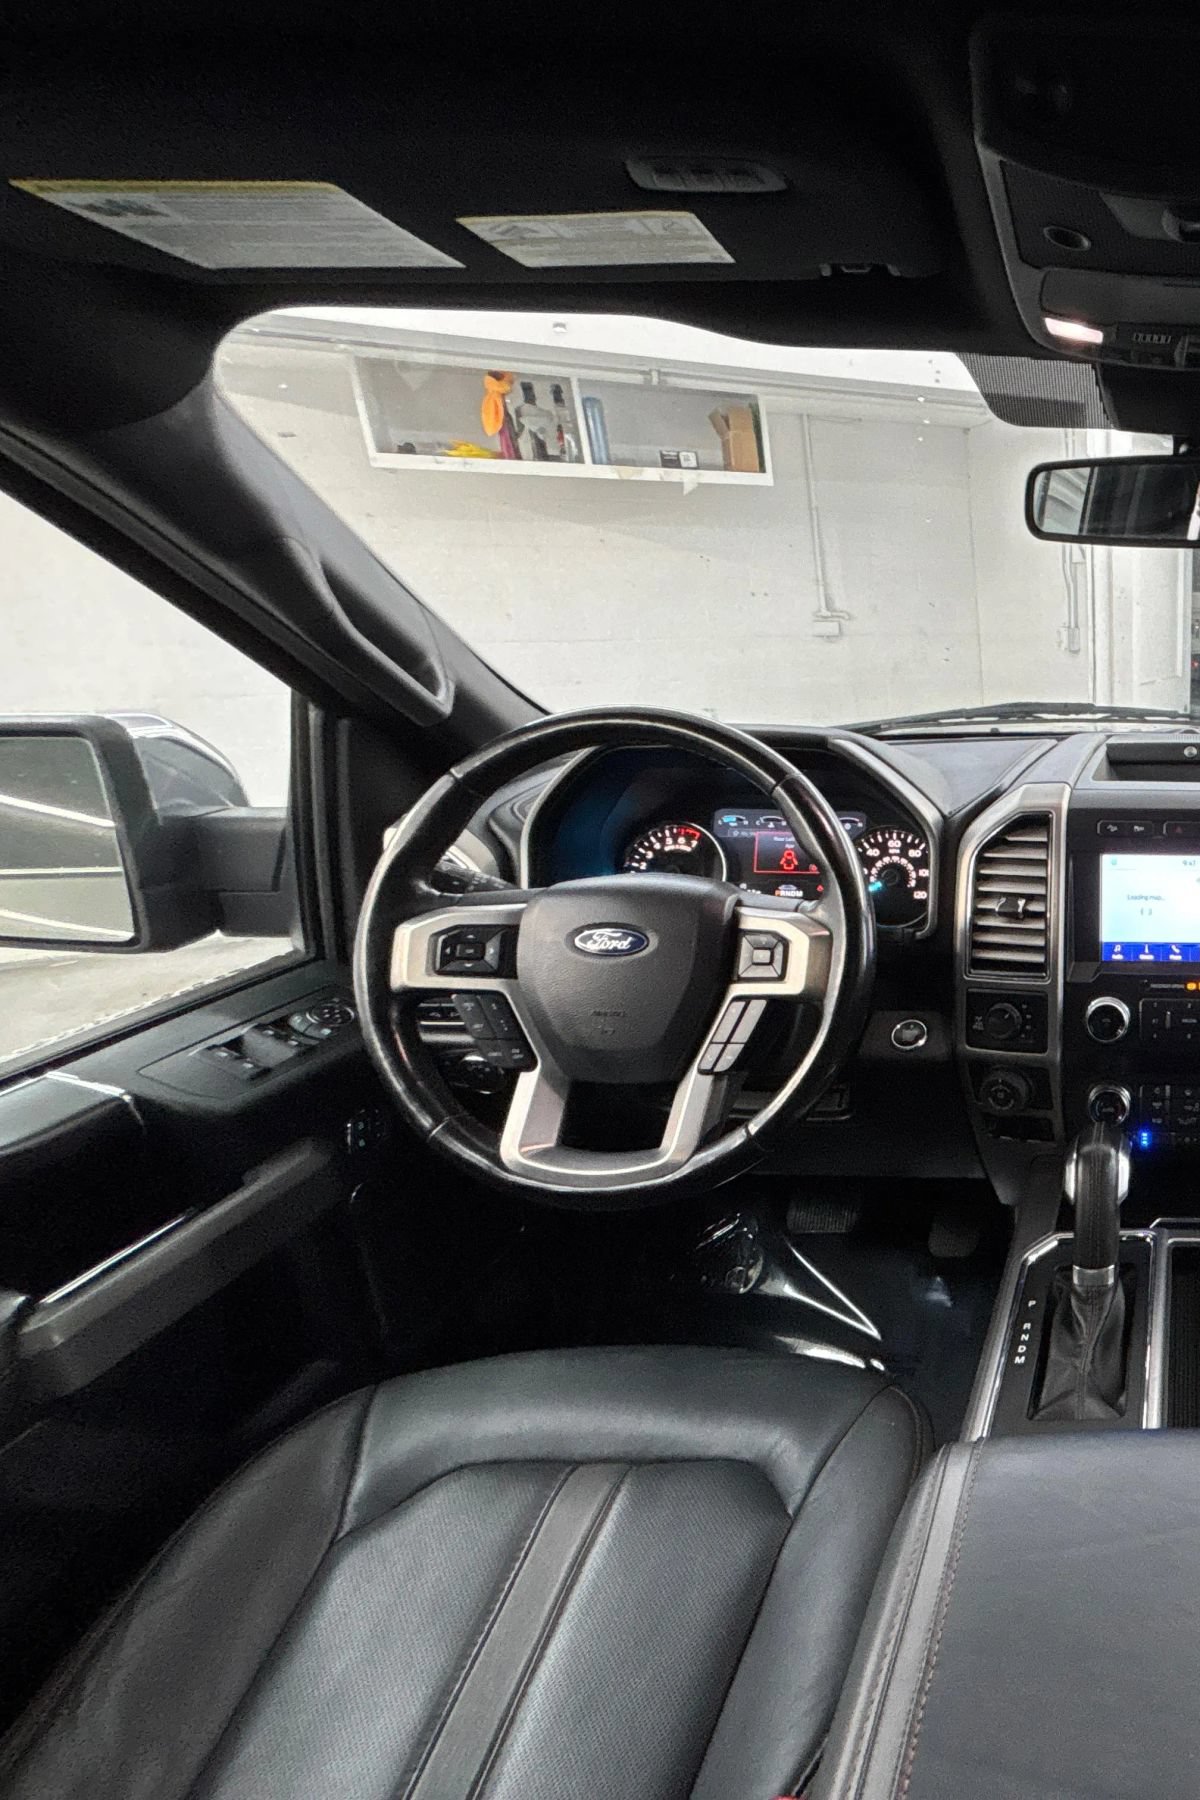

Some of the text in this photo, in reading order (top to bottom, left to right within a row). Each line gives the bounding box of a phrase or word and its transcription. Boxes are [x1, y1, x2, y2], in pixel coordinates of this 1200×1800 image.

[666, 837, 673, 845] 5
[678, 836, 686, 844] 6
[691, 839, 699, 848] 7
[887, 840, 902, 848] 60
[654, 842, 662, 850] 4
[646, 850, 653, 859] 3
[866, 848, 880, 857] 40
[908, 849, 922, 858] 80
[639, 862, 647, 870] 2
[586, 931, 633, 950] Ford
[1020, 1333, 1029, 1341] N
[1017, 1345, 1027, 1353] D
[1014, 1355, 1026, 1364] M
